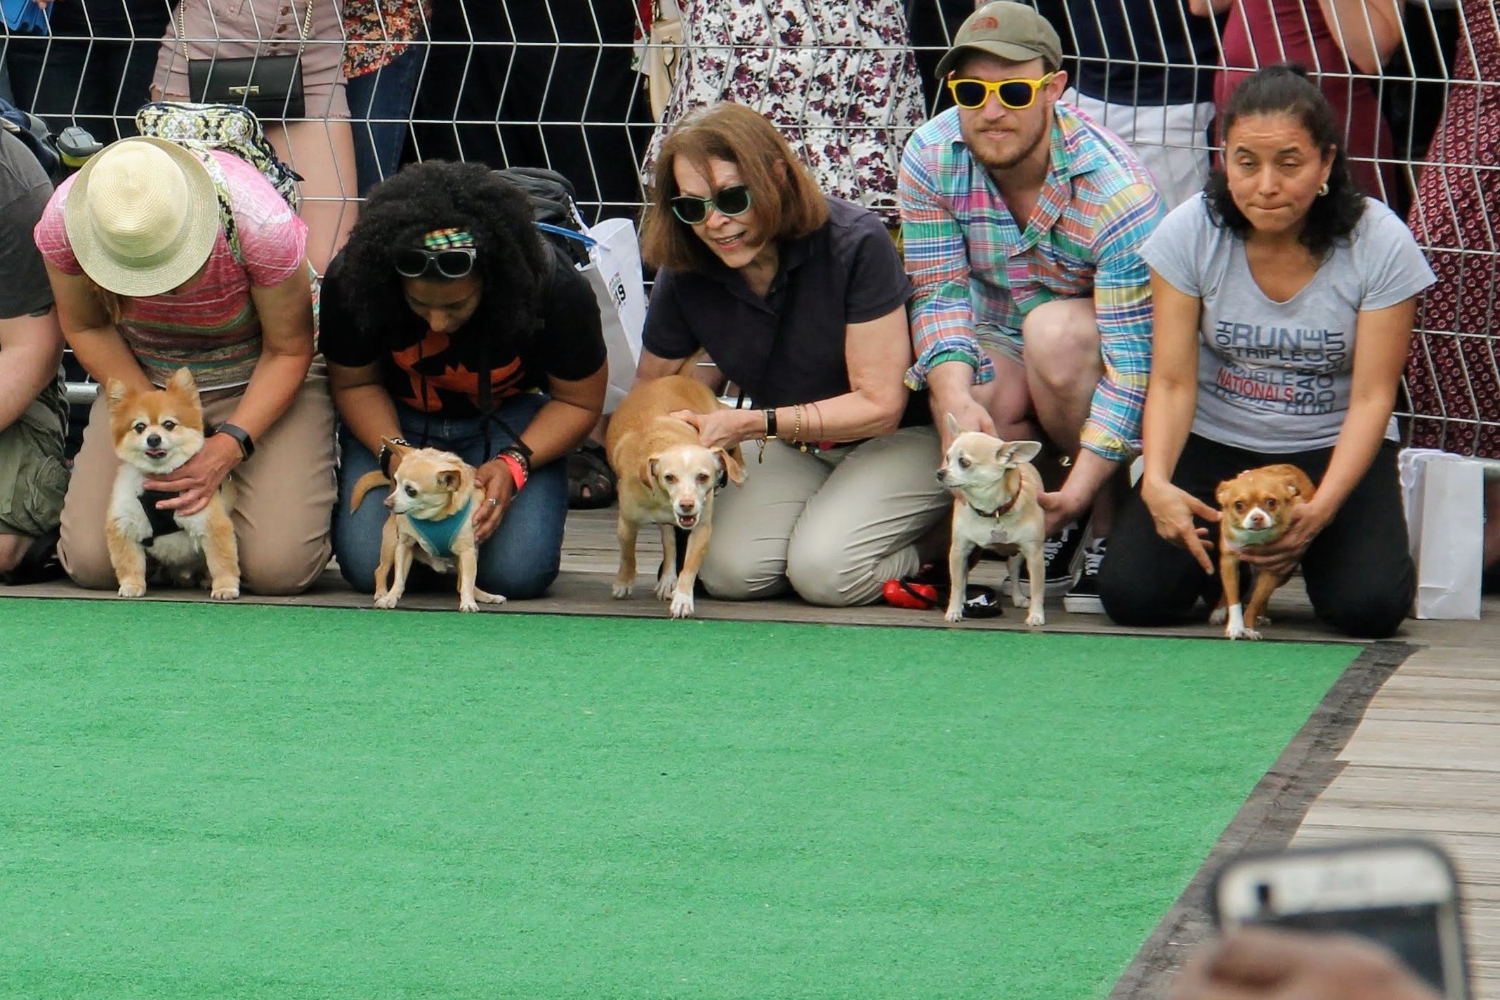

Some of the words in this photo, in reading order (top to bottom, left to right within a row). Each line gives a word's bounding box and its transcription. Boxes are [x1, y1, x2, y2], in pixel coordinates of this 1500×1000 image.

[1232, 322, 1302, 350] RUN
[1232, 346, 1303, 362] TRIPLE
[1216, 367, 1295, 403] NATIONALS
